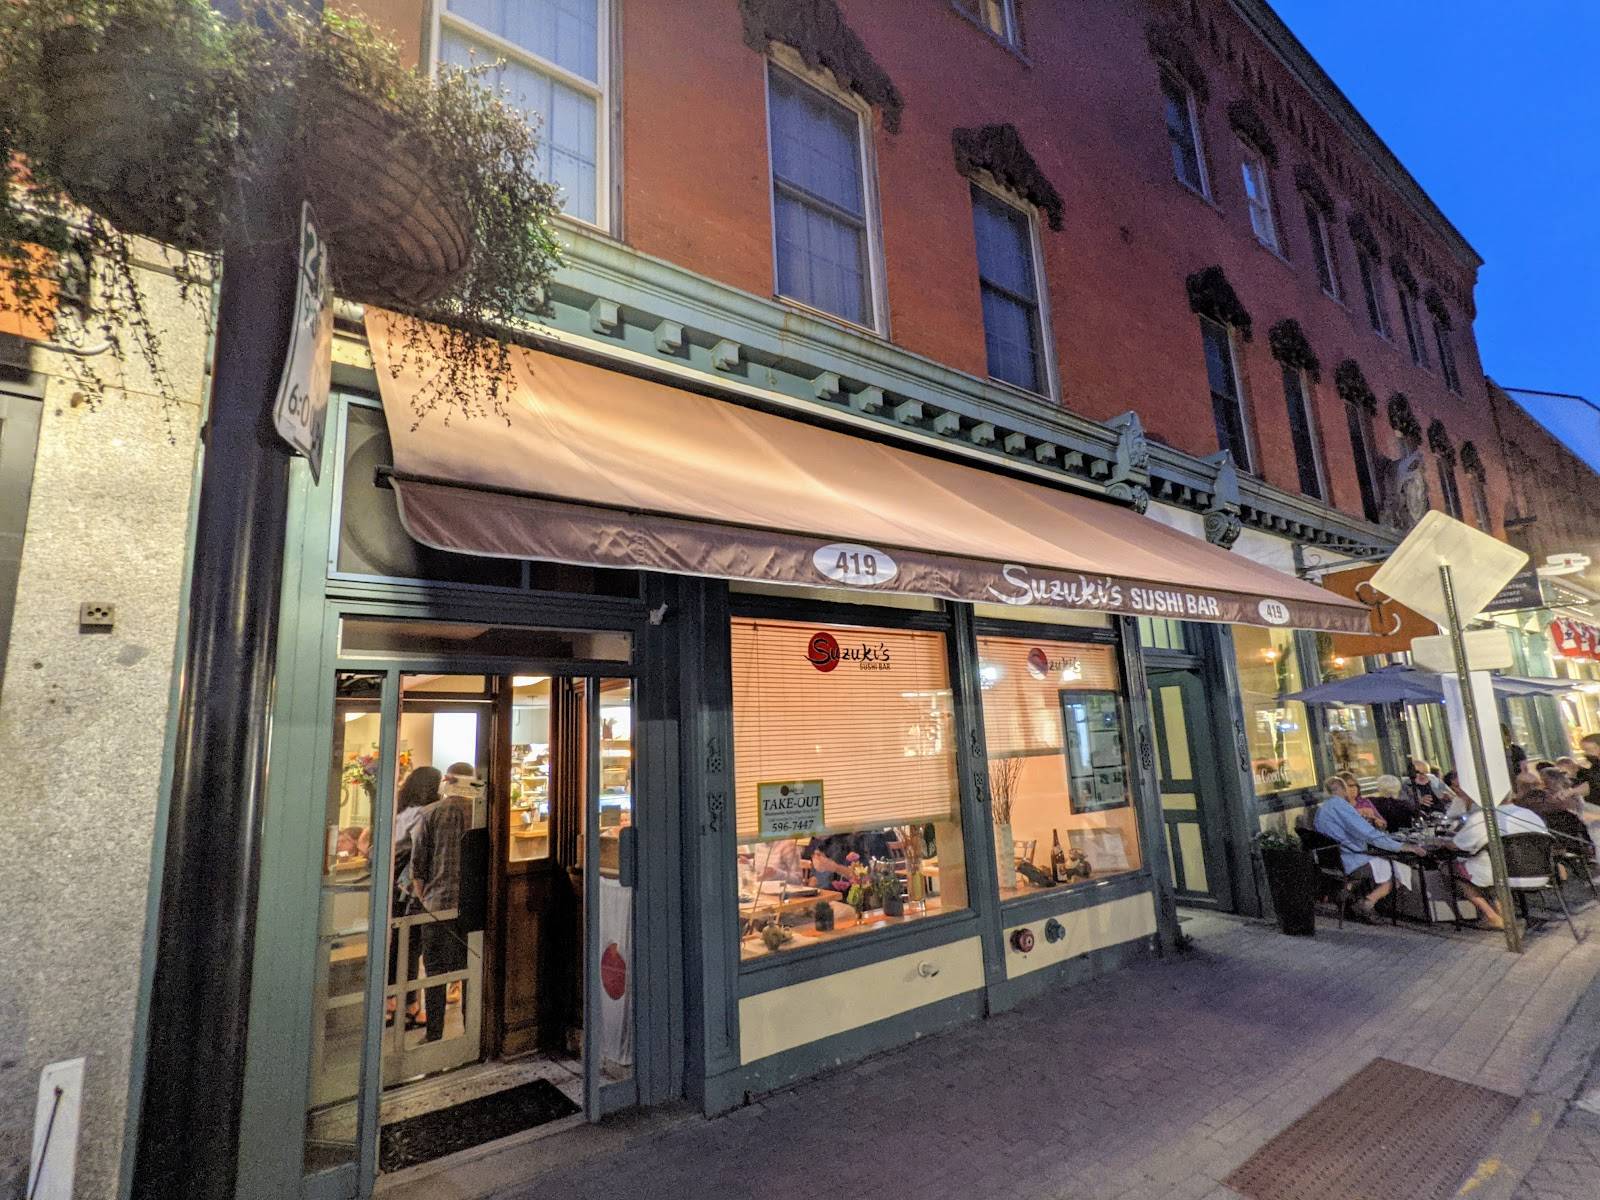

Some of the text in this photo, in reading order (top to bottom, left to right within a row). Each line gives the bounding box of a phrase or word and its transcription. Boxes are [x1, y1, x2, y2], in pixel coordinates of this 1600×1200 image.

[835, 551, 878, 578] 419
[987, 563, 1221, 617] Suzuki's SUSHI BAR
[1265, 603, 1283, 619] 419
[802, 638, 890, 666] Suzuki's
[762, 795, 822, 811] TAKE-OUT
[771, 819, 815, 833] 596-7447
